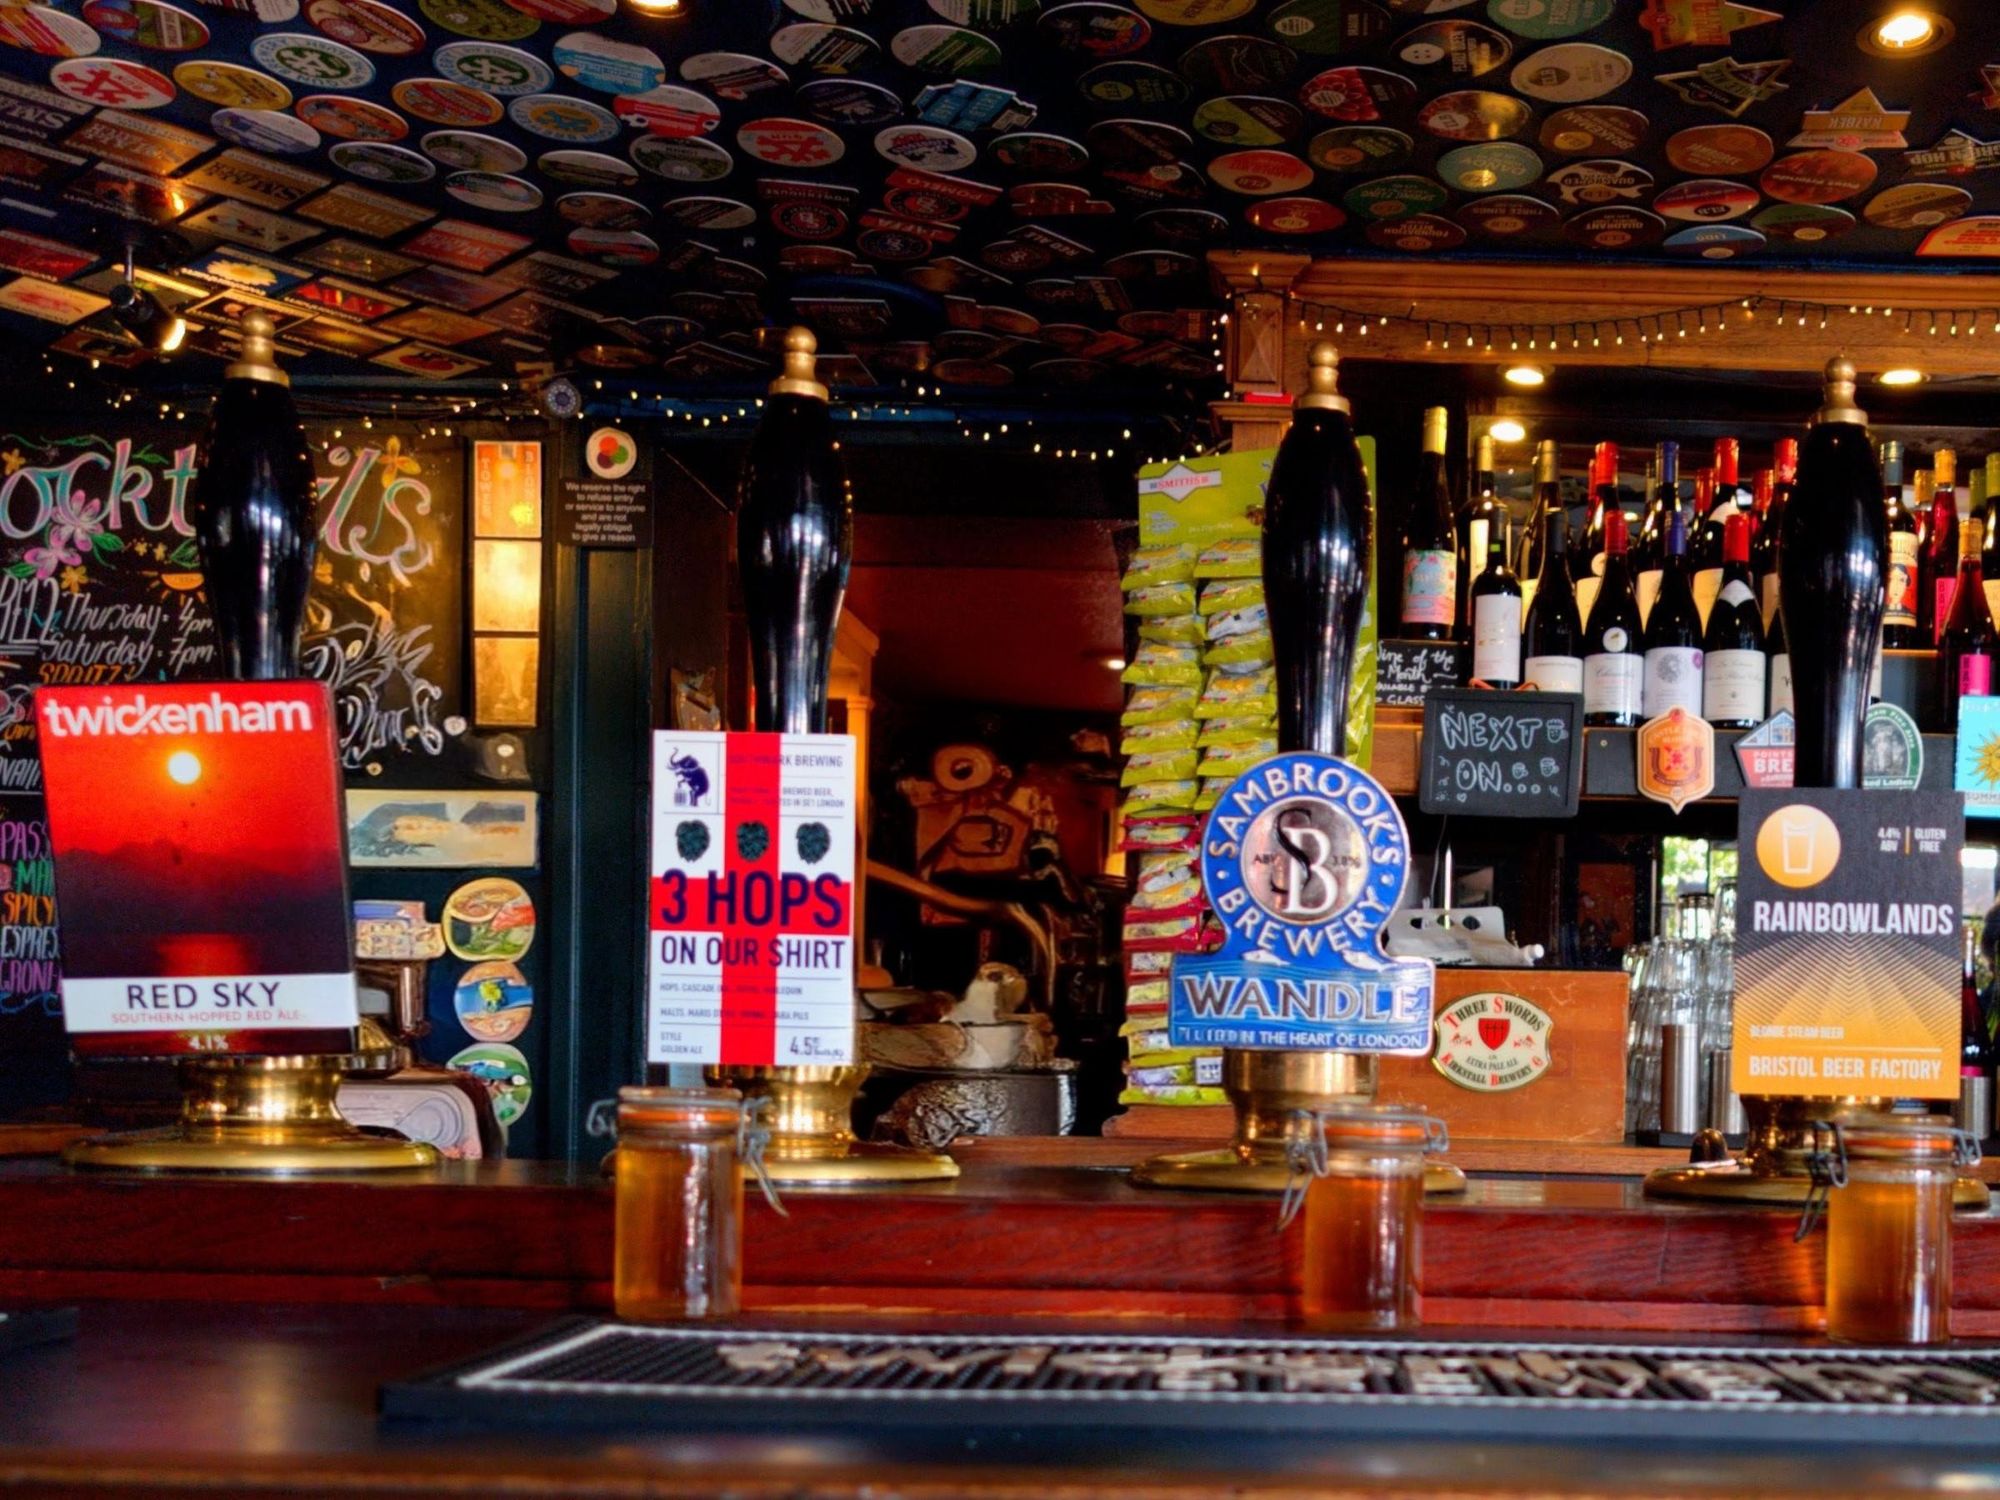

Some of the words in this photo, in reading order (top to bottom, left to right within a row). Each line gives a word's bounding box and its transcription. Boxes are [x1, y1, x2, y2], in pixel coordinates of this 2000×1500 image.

[565, 482, 580, 491] We
[581, 484, 611, 492] reserve
[613, 484, 626, 492] the
[627, 484, 646, 495] right
[577, 493, 586, 501] to
[587, 493, 612, 502] refuse
[613, 495, 634, 504] entry
[581, 513, 597, 521] and
[613, 514, 627, 522] not
[605, 503, 615, 512] to
[615, 505, 646, 514] anyone
[575, 522, 602, 533] legally
[602, 523, 633, 533] obliged
[571, 532, 581, 541] to
[582, 533, 599, 543] give
[607, 533, 636, 542] reason
[1430, 650, 1455, 671] the
[1387, 664, 1432, 684] Month
[44, 691, 312, 737] twickenham
[1440, 711, 1543, 752] NEXT
[794, 755, 843, 768] BREWING
[1209, 763, 1401, 864] SAMBROOK'S
[1914, 827, 1947, 841] GLUTEN
[1879, 840, 1898, 852] ABV
[1919, 841, 1940, 853] FREE
[661, 868, 688, 925] 3
[707, 869, 843, 929] HOPS
[1217, 885, 1390, 957] BREWERY
[1753, 900, 1954, 935] RAINBOWLANDS
[661, 935, 697, 965] ON
[706, 936, 760, 966] OUR
[768, 938, 846, 969] SHIRT
[127, 983, 198, 1009] RED
[213, 981, 281, 1008] SKY
[1179, 971, 1425, 1024] WANDLE
[112, 1011, 185, 1025] SOUTHERN
[188, 1010, 242, 1022] HOPPED
[247, 1009, 273, 1021] RED
[1443, 999, 1489, 1029] THREE
[1493, 995, 1546, 1032] SWORDS
[188, 1034, 229, 1051] 4.1%
[1260, 1030, 1289, 1044] THE
[1289, 1031, 1332, 1046] HEART
[1336, 1032, 1357, 1046] OF
[1358, 1032, 1423, 1048] LONDON
[1749, 1055, 1818, 1077] BRISTOL
[1822, 1057, 1865, 1078] BEER
[1869, 1058, 1942, 1080] FACTORY
